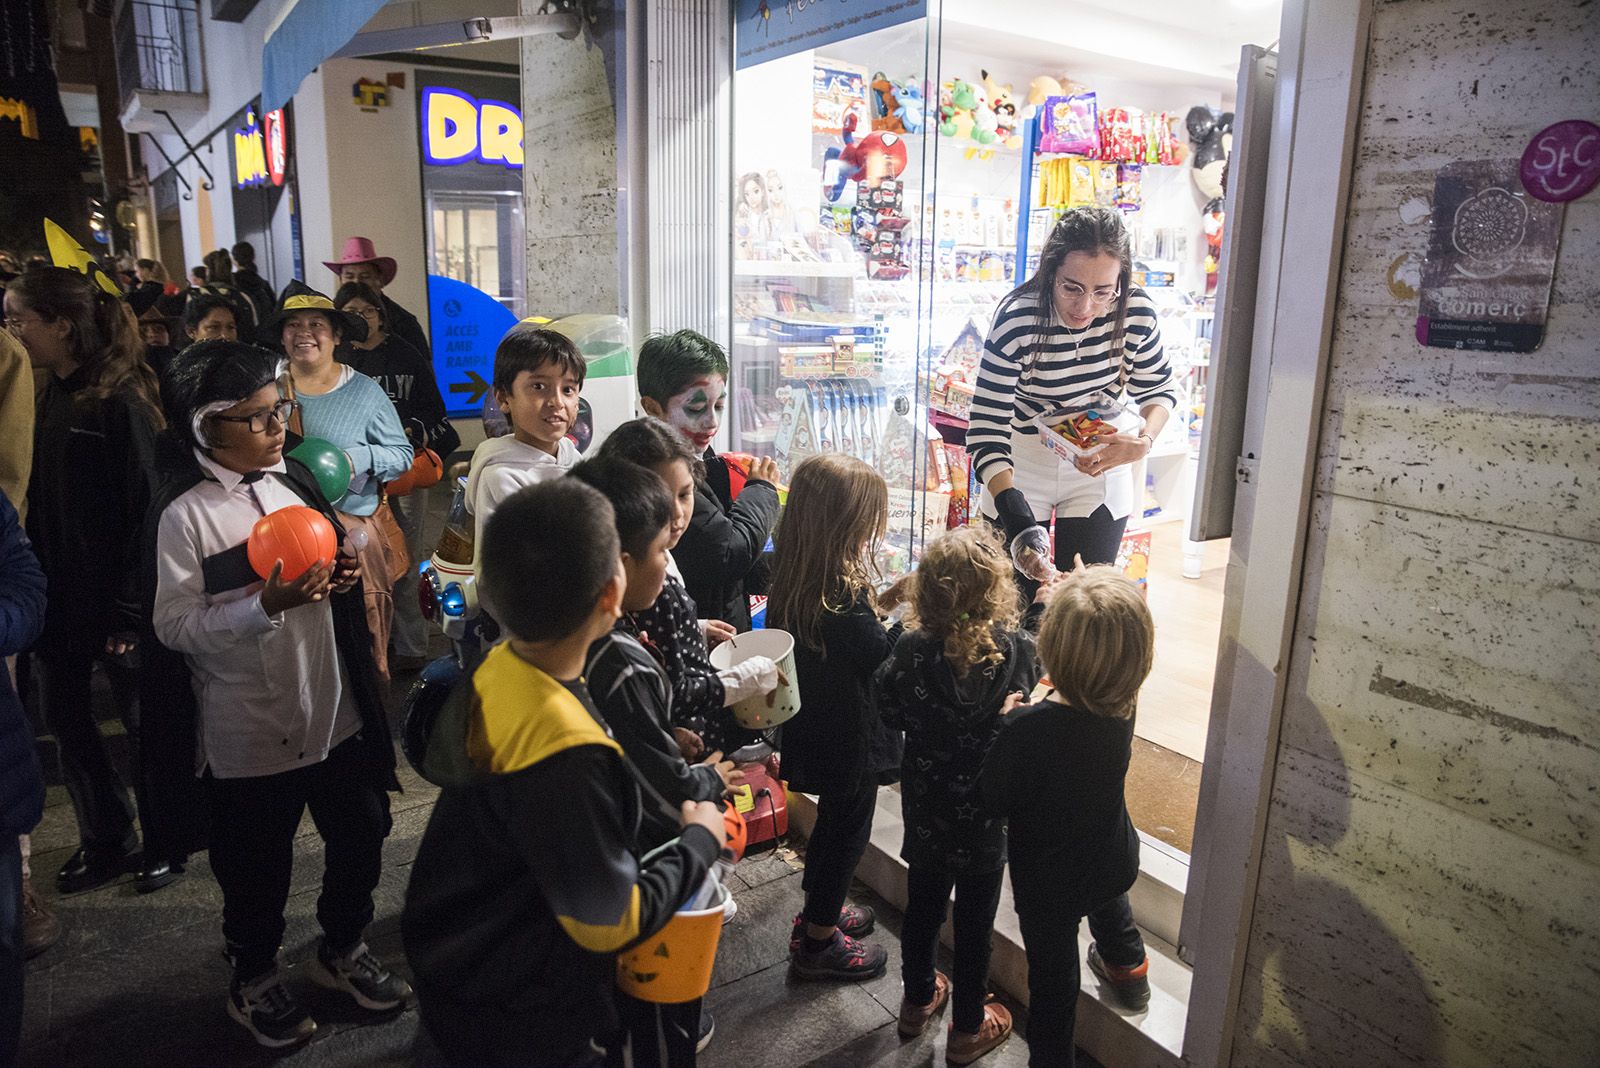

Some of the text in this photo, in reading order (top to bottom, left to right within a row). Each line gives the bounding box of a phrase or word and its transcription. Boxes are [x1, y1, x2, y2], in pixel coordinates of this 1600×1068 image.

[1532, 135, 1597, 177] StC
[1437, 300, 1527, 321] comerç
[445, 340, 473, 353] AMB
[445, 354, 488, 369] RAMPA
[887, 508, 917, 519] ueno
